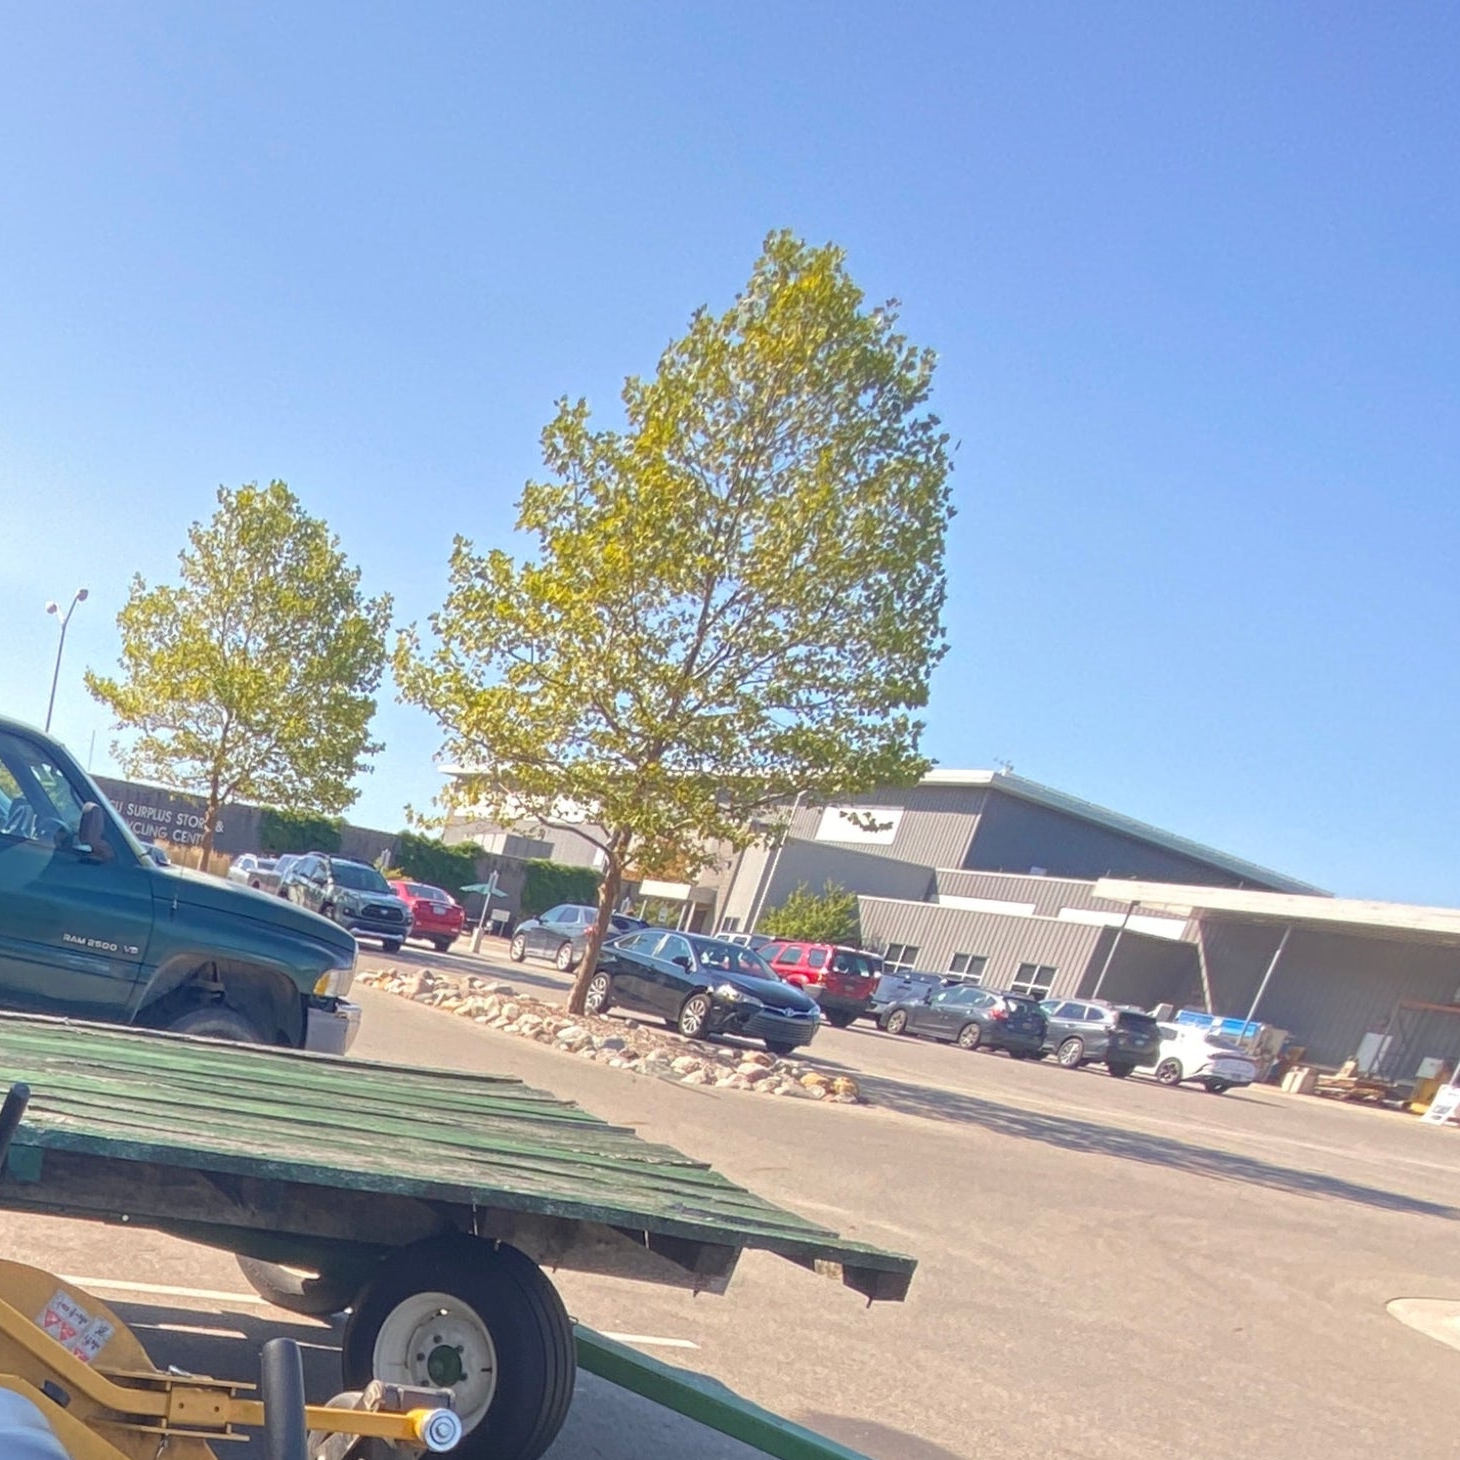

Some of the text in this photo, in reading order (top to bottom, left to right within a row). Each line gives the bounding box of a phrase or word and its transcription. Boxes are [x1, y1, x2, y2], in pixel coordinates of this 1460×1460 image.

[126, 803, 172, 823] SURPLUS
[175, 813, 209, 829] STOR
[215, 820, 224, 832] &
[172, 829, 205, 845] CENT
[63, 933, 86, 944] RAM
[87, 938, 117, 951] 2500
